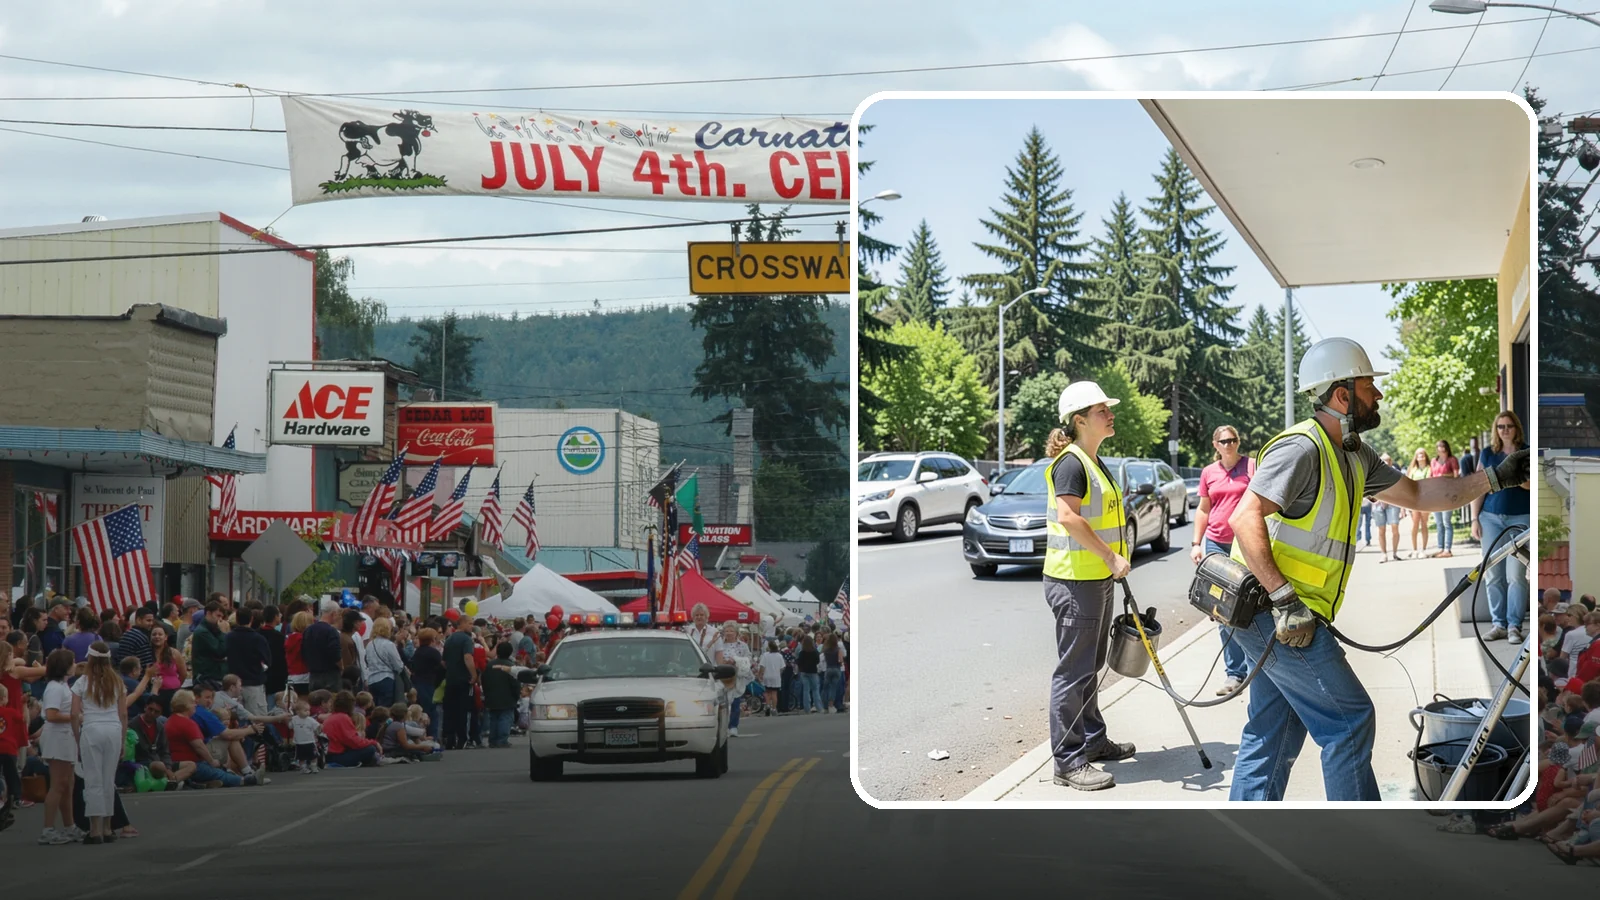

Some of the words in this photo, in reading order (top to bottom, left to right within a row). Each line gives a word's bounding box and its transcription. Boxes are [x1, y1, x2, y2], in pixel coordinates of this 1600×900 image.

[481, 140, 604, 192] JULY
[632, 150, 746, 197] 4th.
[696, 253, 850, 280] CROSSWA
[282, 380, 373, 420] ACE
[405, 408, 453, 422] CEDAR
[283, 421, 371, 436] Hardware
[353, 467, 384, 481] Simpl
[95, 485, 124, 495] Vincent
[126, 486, 135, 495] de
[137, 486, 155, 495] Paul
[212, 516, 331, 536] HARDARE
[688, 526, 742, 535] CRNATION
[699, 535, 730, 543] GLASS
